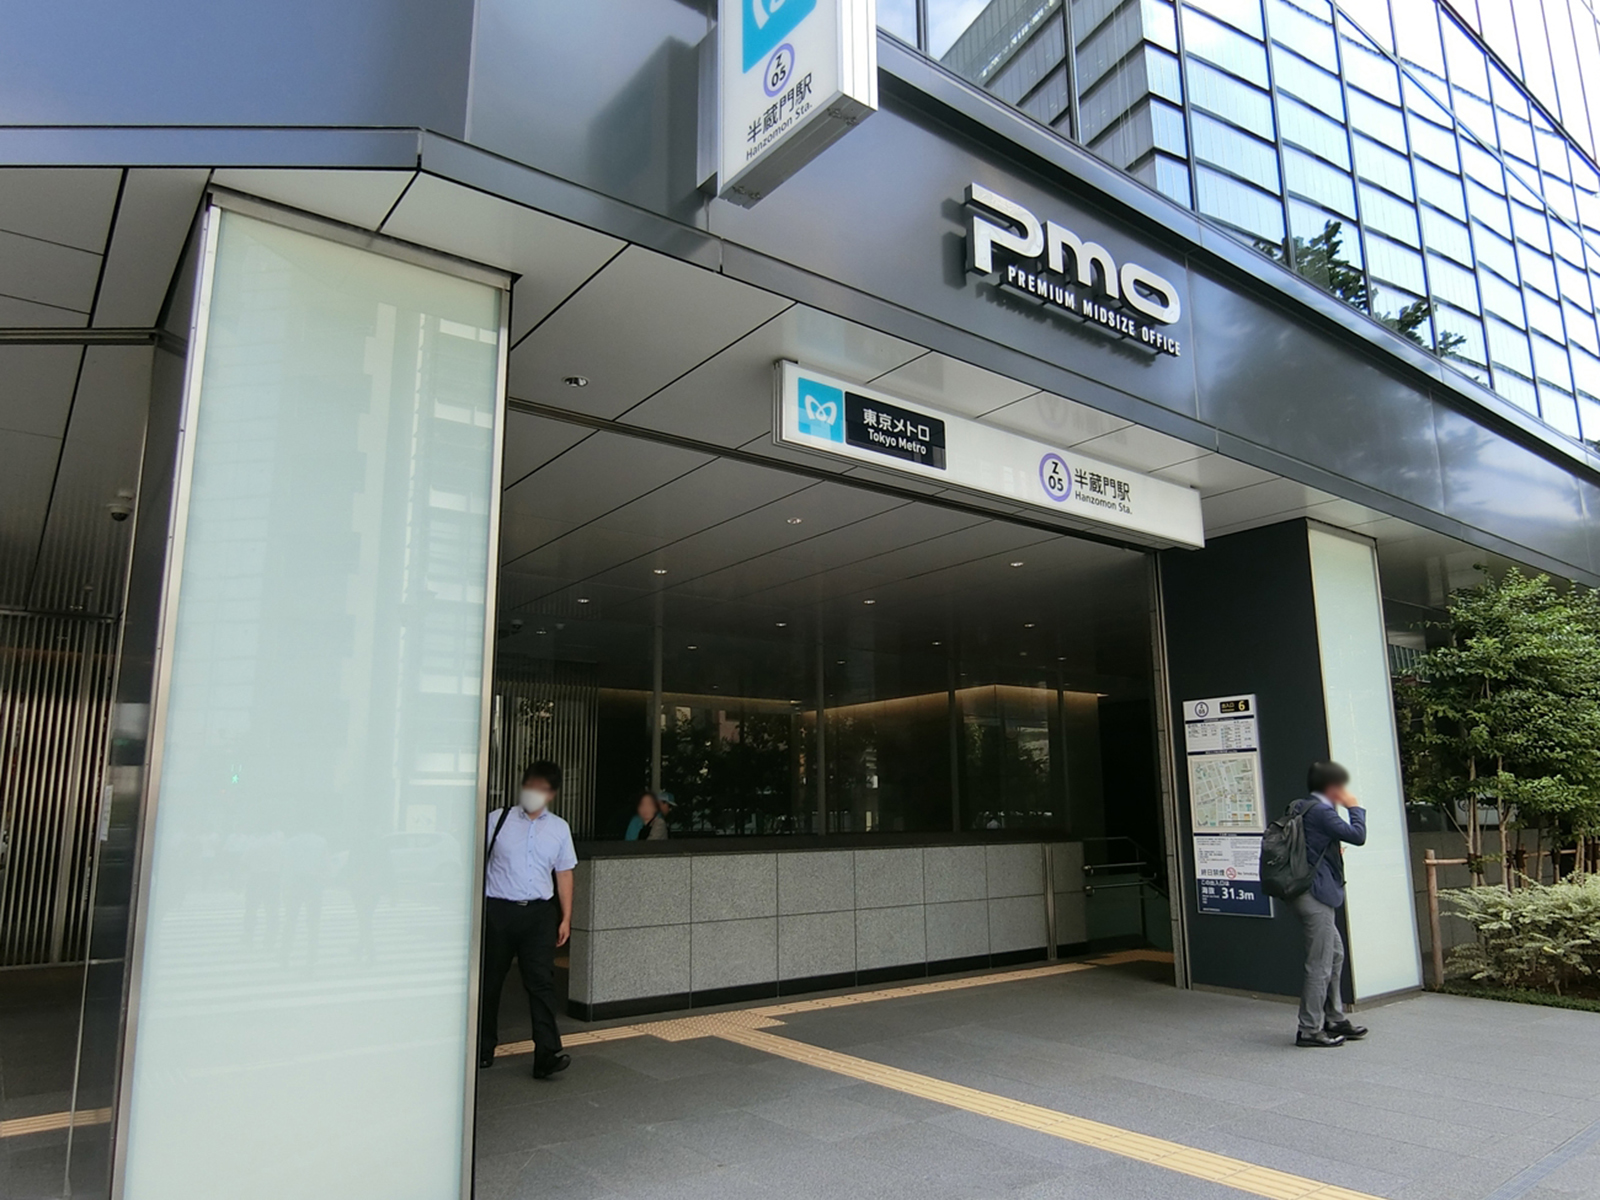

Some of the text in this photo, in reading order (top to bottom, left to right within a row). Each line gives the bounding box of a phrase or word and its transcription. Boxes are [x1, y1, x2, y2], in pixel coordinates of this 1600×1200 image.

[775, 53, 783, 70] Z
[771, 66, 787, 88] 05
[747, 72, 812, 143] 半蔵門駅
[746, 102, 813, 161] Hanzomon Sta.
[1008, 265, 1182, 357] PREMIUM MIDSIZE OFFICE
[863, 408, 930, 442] 東京メトロ
[867, 428, 927, 456] Tokyo Metro
[1051, 461, 1060, 475] Z
[1048, 475, 1064, 492] 05
[1074, 468, 1131, 502] 半蔵門駅
[1075, 490, 1133, 515] Hanzomon Sta.
[1238, 700, 1246, 711] 6
[1221, 887, 1254, 900] 31.3m
